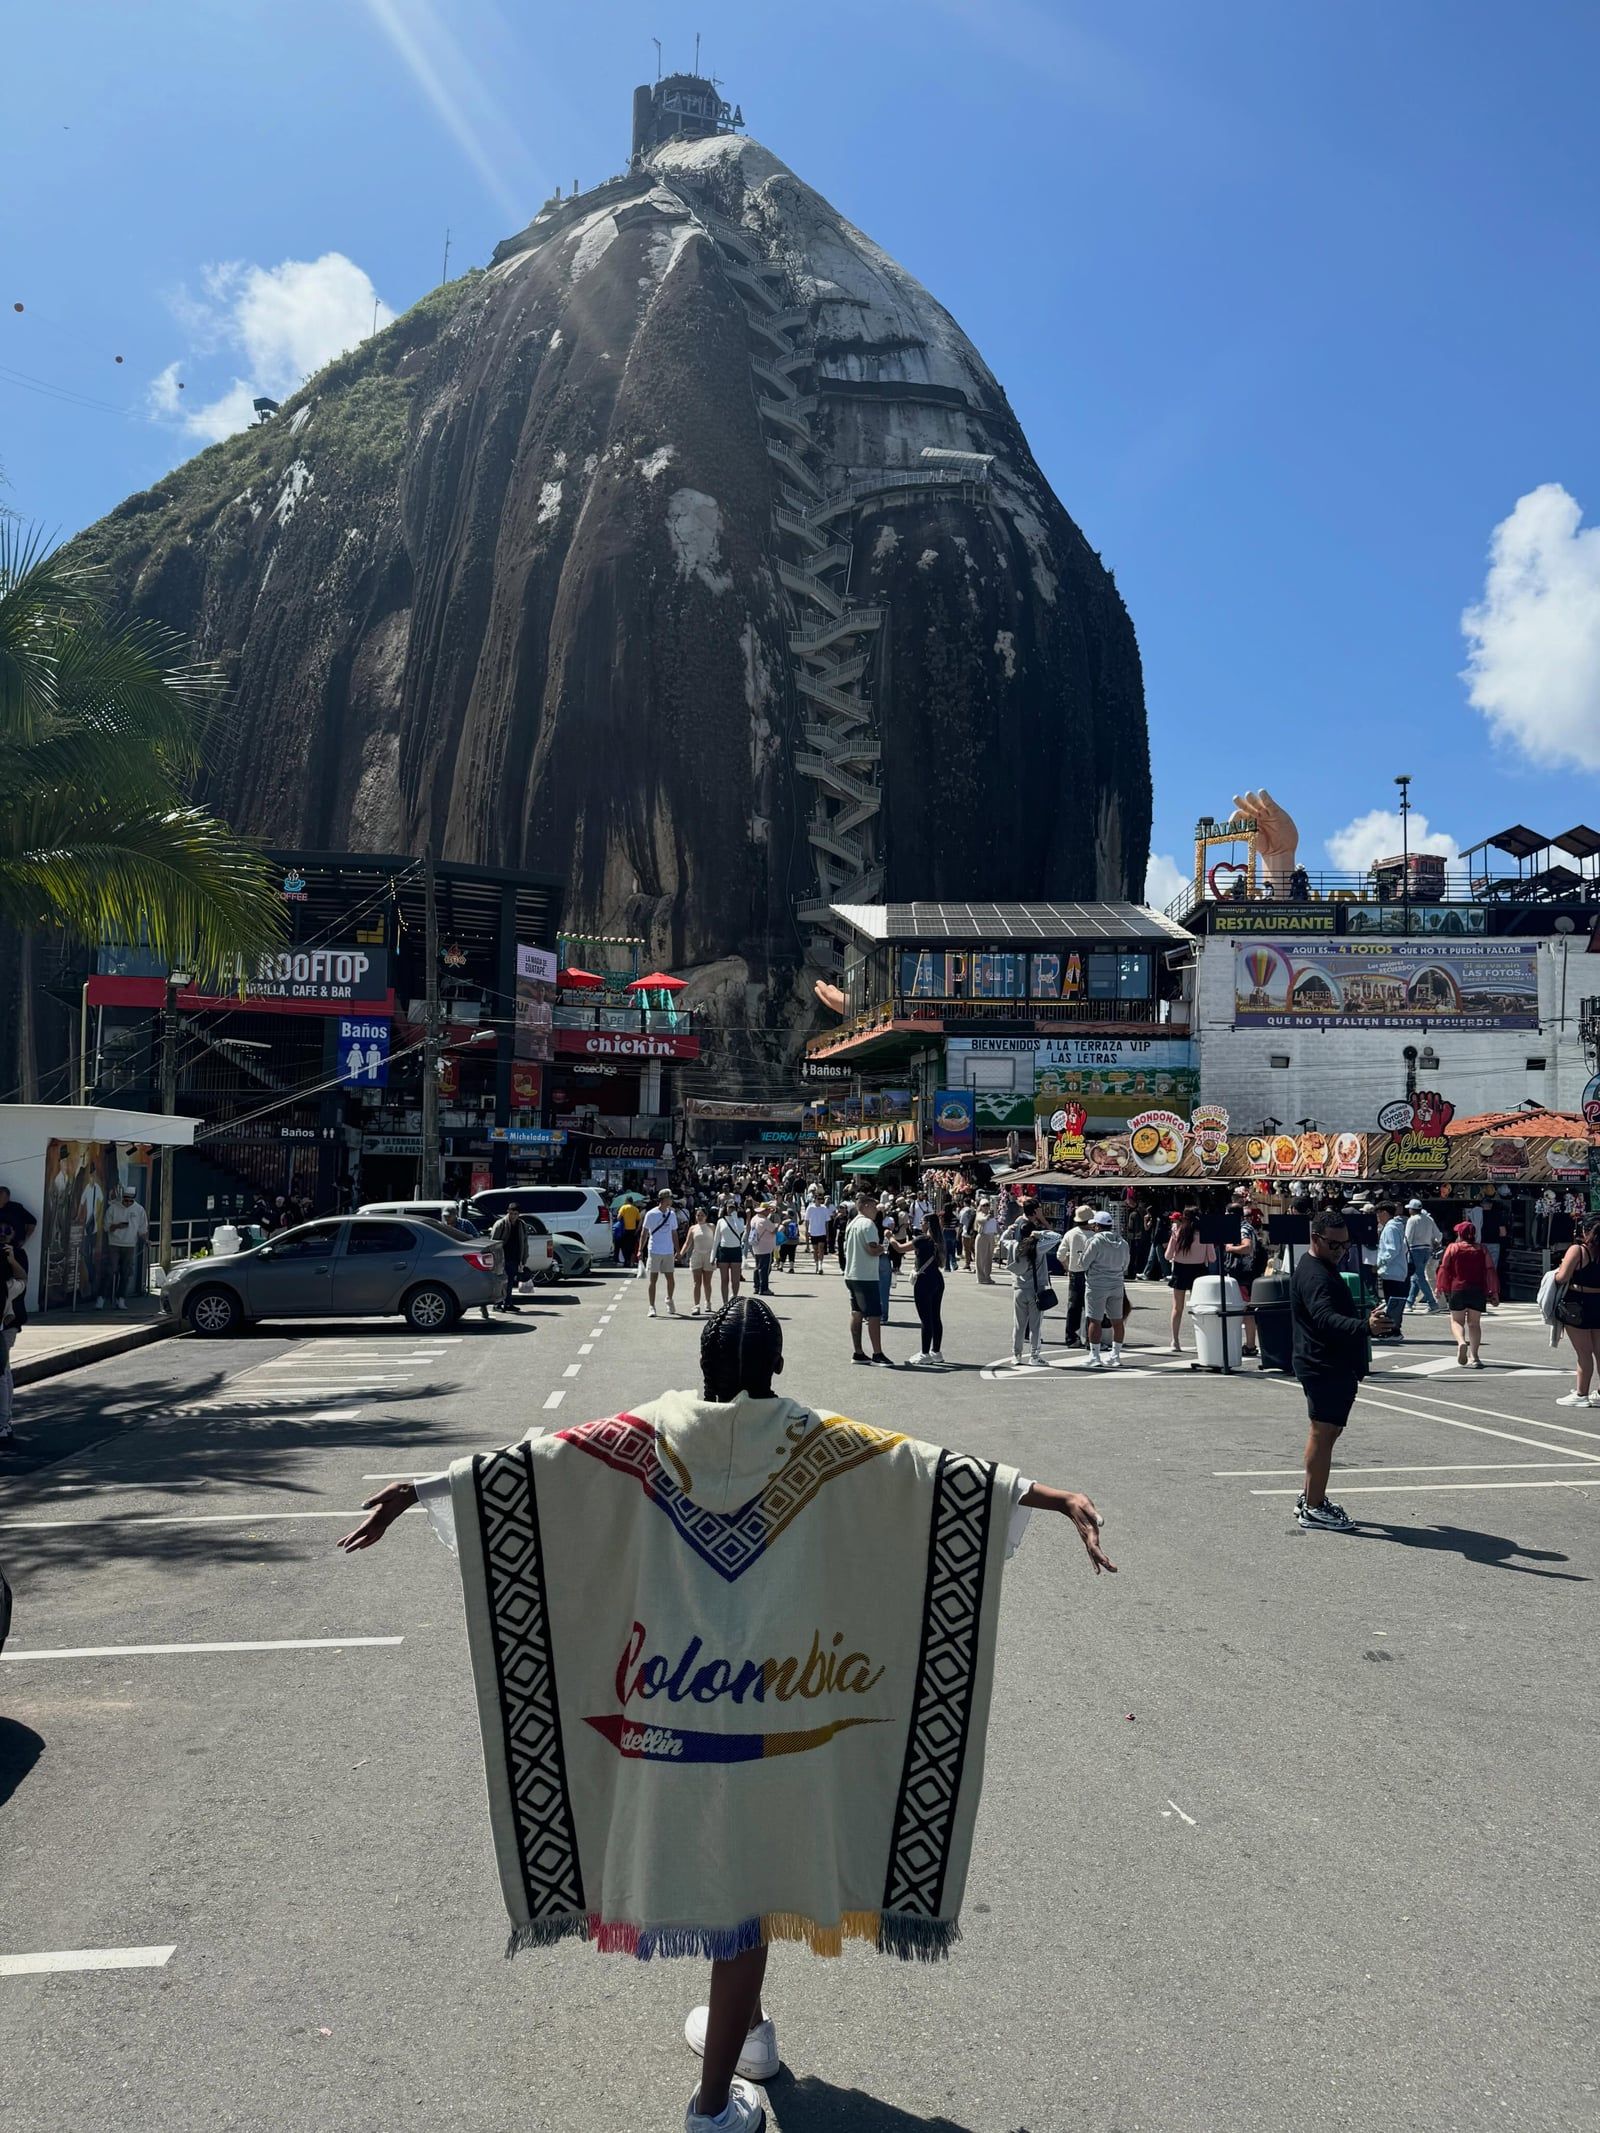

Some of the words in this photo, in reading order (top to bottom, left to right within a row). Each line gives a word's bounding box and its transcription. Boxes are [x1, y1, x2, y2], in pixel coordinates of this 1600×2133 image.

[1215, 916, 1334, 931] RESTAURANTE
[1338, 944, 1347, 954] 4
[1350, 944, 1393, 954] FOTOS
[1399, 947, 1418, 955] QUE
[1486, 946, 1521, 954] FALTAR
[260, 950, 370, 984] ROOFTOP
[237, 983, 289, 997] ARRILLA,
[292, 984, 318, 997] CAFE
[320, 985, 328, 997] &
[331, 985, 352, 998] BAR
[1267, 1016, 1291, 1026] QUE
[1296, 1017, 1312, 1026] NO
[1317, 1017, 1331, 1026] TE
[1335, 1017, 1379, 1026] FALTEN
[1384, 1018, 1422, 1026] ESTOS
[1427, 1018, 1501, 1027] RECUERDOS
[341, 1021, 388, 1039] Baños
[971, 1038, 1041, 1052] BIENVENIDOS
[1046, 1040, 1053, 1051] A
[1057, 1040, 1070, 1051] LA
[1074, 1040, 1123, 1051] TERRAZA
[1130, 1041, 1151, 1052] VIP
[1051, 1053, 1072, 1064] LAS
[1077, 1053, 1118, 1064] LETRAS
[573, 1063, 618, 1077] cosechas
[810, 1064, 842, 1077] Baños
[1133, 1112, 1185, 1131] MONDONGO
[281, 1127, 315, 1138] Baños
[1401, 1130, 1447, 1150] Mano
[588, 1142, 603, 1155] La
[1381, 1143, 1449, 1173] Gigante
[615, 1620, 886, 1706] Colombia
